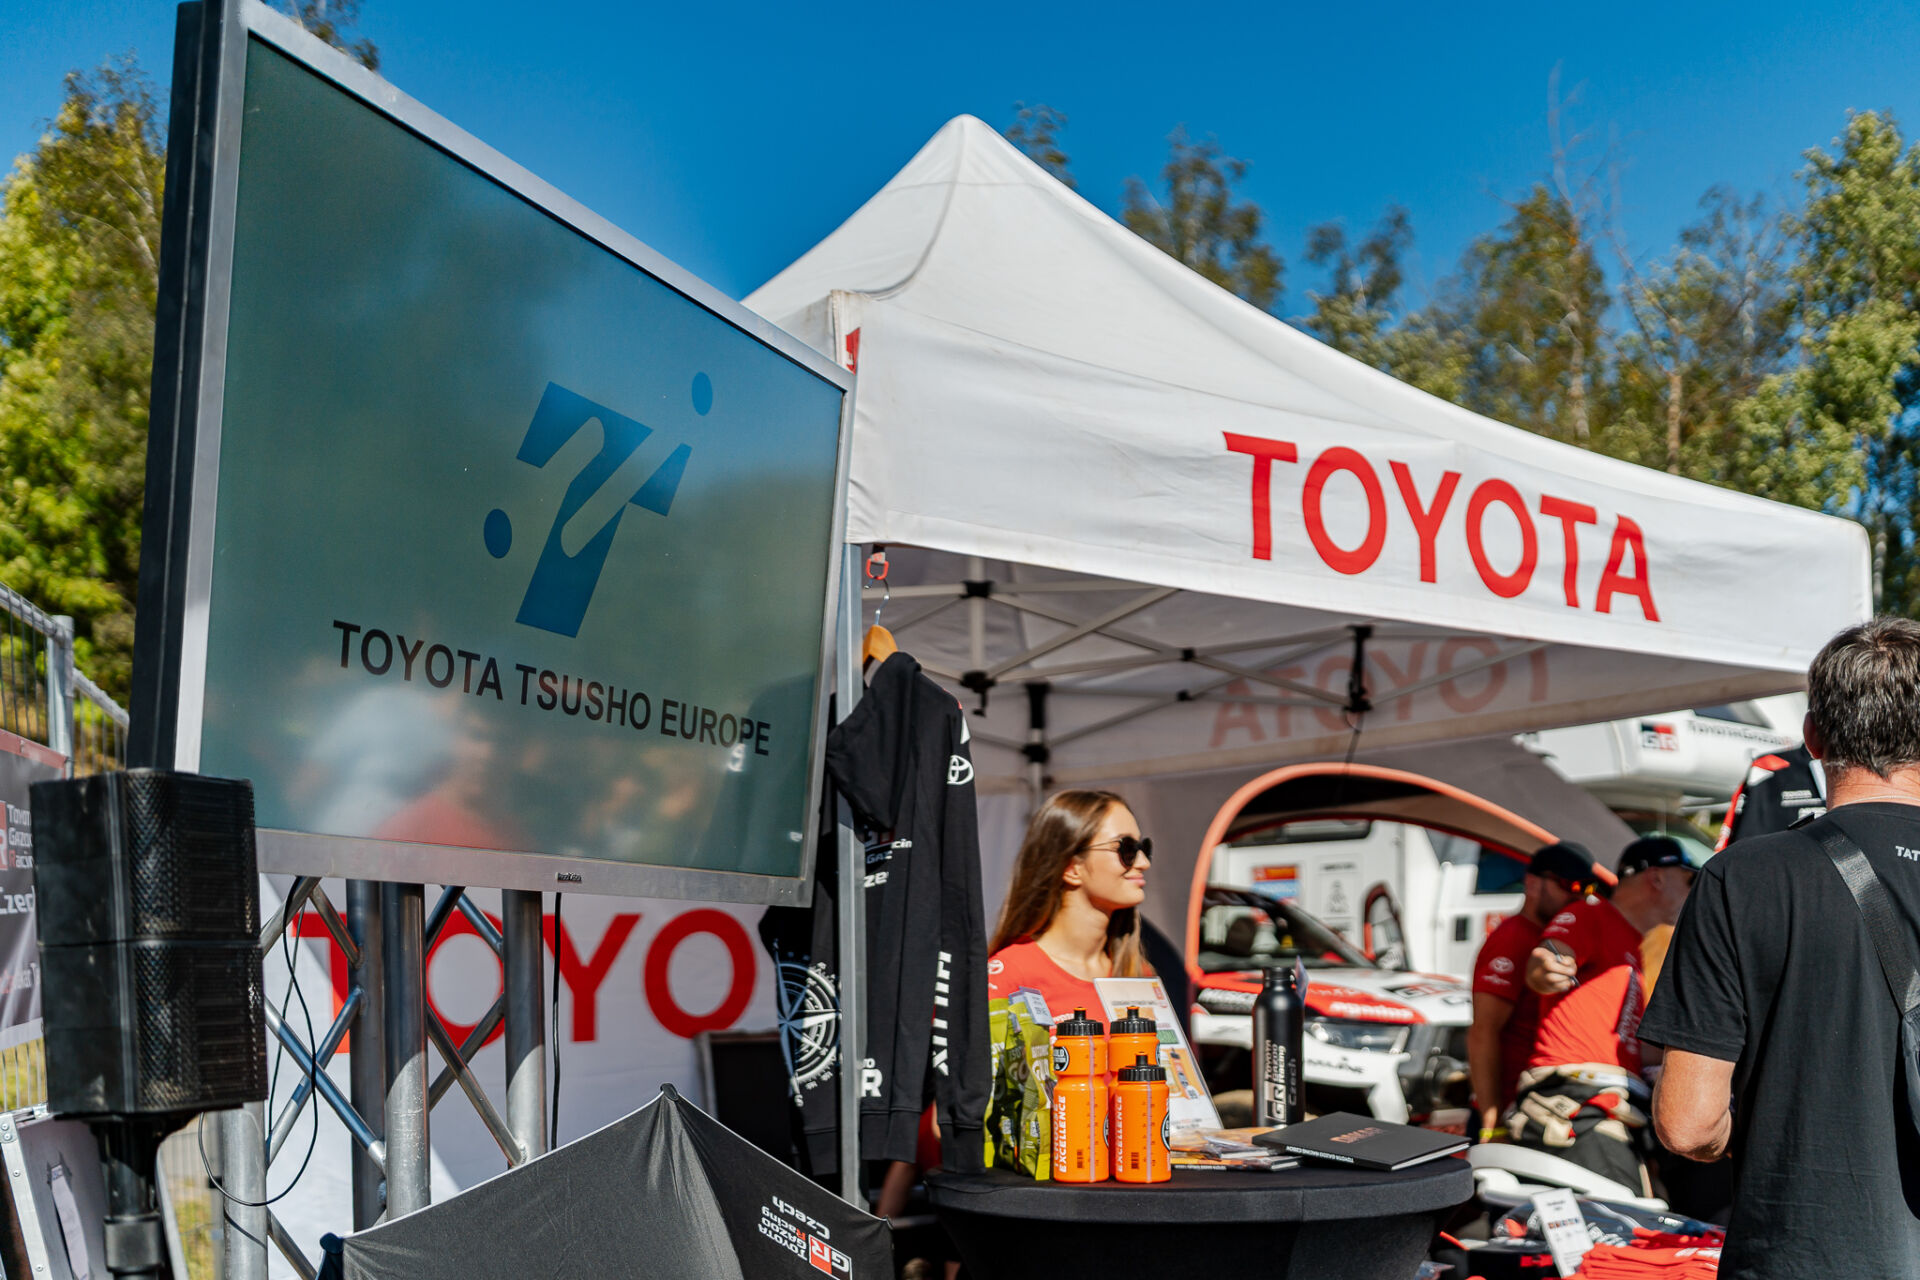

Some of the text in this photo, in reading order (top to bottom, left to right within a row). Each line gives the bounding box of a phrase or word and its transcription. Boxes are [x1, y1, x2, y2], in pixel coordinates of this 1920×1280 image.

[1222, 431, 1661, 622] TOYOTA
[333, 620, 771, 757] TOYOTA TSUSHO EUROPE
[7, 804, 32, 824] TOYOT
[8, 828, 33, 848] GAZO
[1895, 845, 1920, 861] TAT
[8, 850, 34, 869] Racin
[292, 909, 756, 1053] TOYO
[1271, 1084, 1286, 1119] GR
[1058, 1096, 1067, 1173] EXCELLENCE
[1114, 1096, 1123, 1173] EXCELLENCE
[761, 1206, 806, 1240] Racing
[761, 1217, 807, 1250] GAZOO
[772, 1195, 830, 1240] Czech
[758, 1223, 808, 1261] TOYOTA
[811, 1240, 850, 1272] GR
